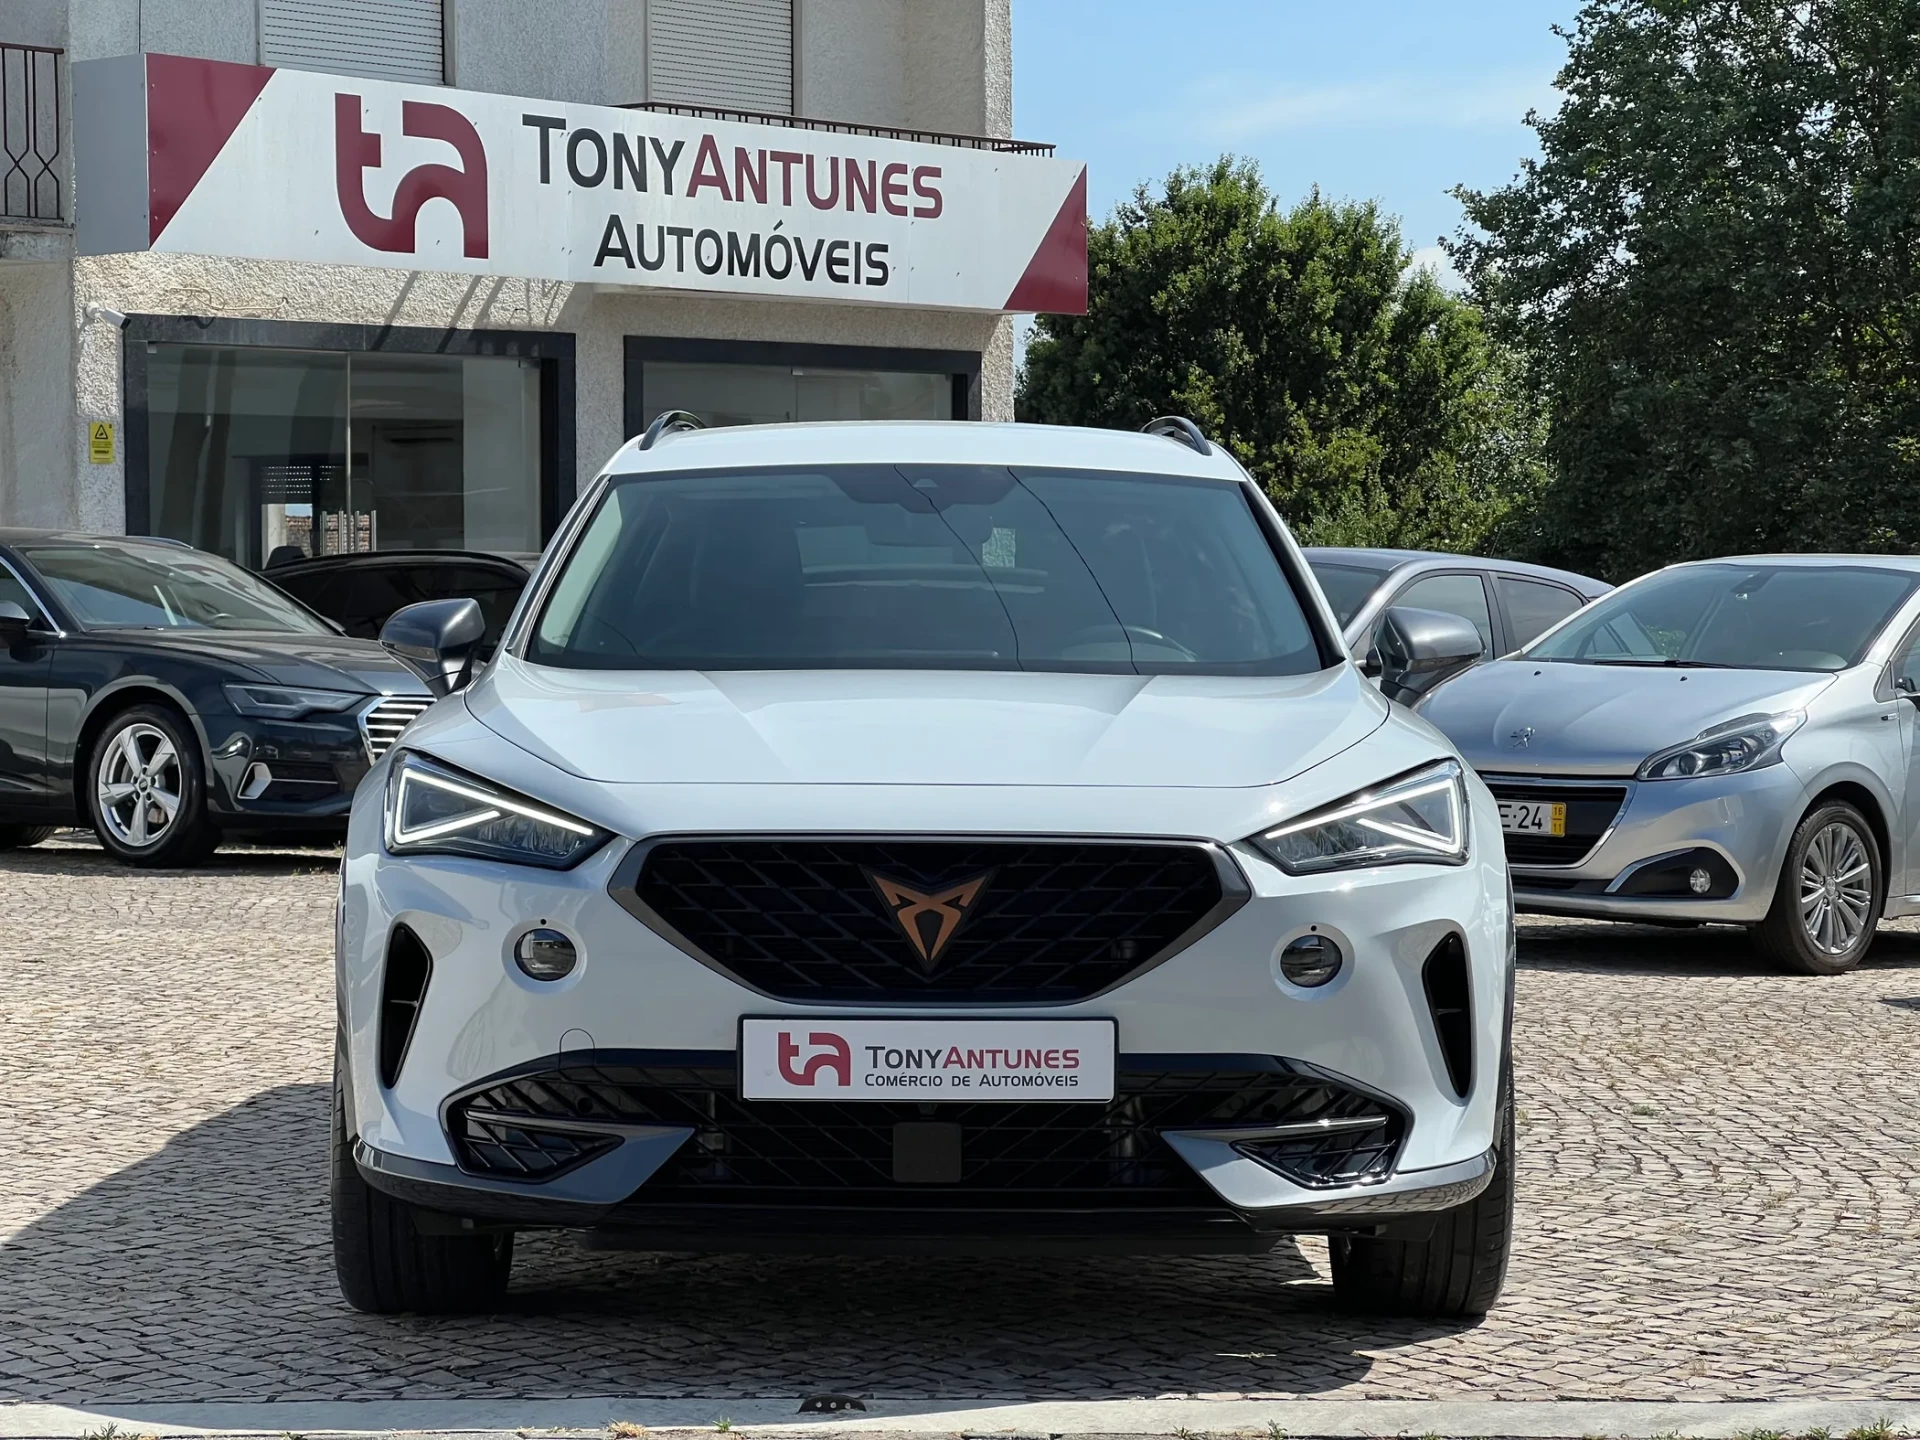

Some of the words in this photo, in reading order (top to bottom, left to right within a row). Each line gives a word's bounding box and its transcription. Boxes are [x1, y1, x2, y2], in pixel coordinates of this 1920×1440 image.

[593, 214, 889, 287] AUTOMÓVEIS
[1553, 806, 1563, 816] 16
[1553, 823, 1563, 833] 11
[864, 1072, 944, 1087] COMÉRCIO
[951, 1075, 971, 1087] DE
[978, 1072, 1079, 1087] AUTOMÓVEIS
